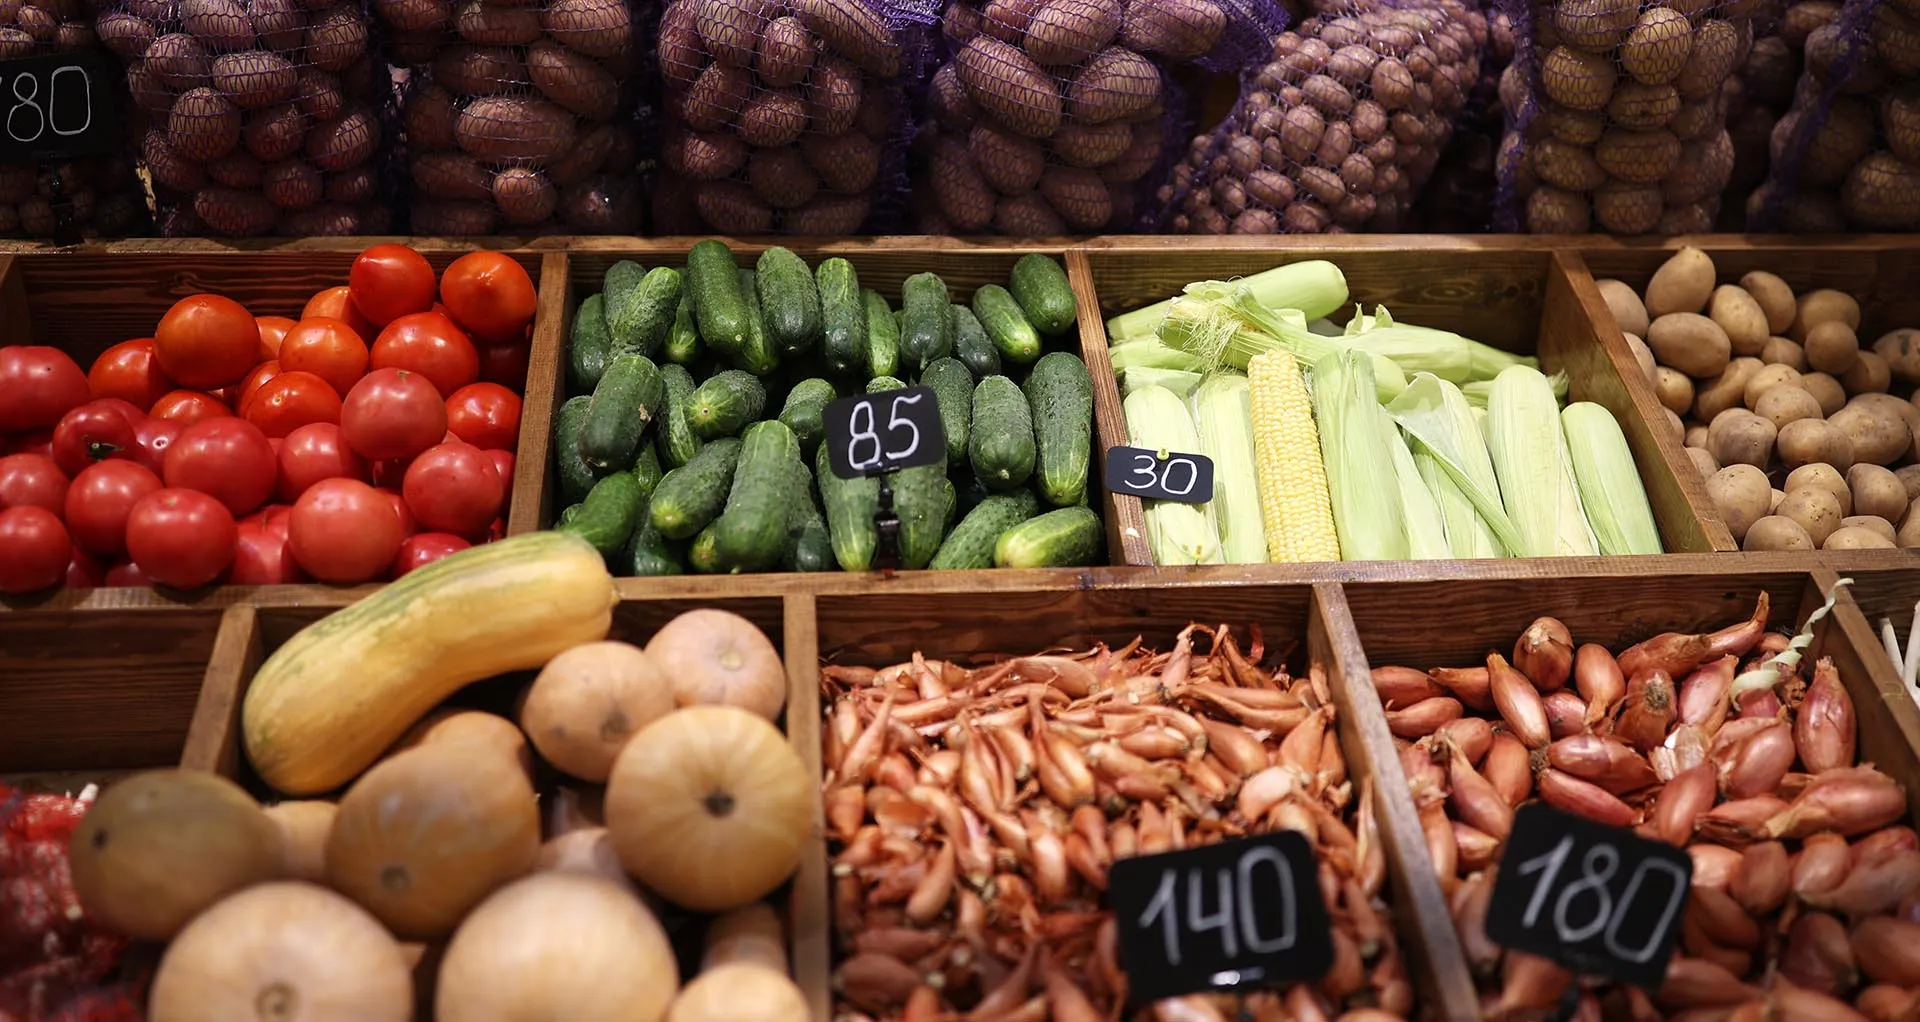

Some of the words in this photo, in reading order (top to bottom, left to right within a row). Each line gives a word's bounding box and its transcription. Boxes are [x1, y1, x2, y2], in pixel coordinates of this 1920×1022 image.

[0, 66, 91, 142] 80
[848, 394, 922, 470] 85
[1124, 455, 1198, 495] 30
[1138, 845, 1297, 966] 140
[1517, 833, 1687, 963] 180
